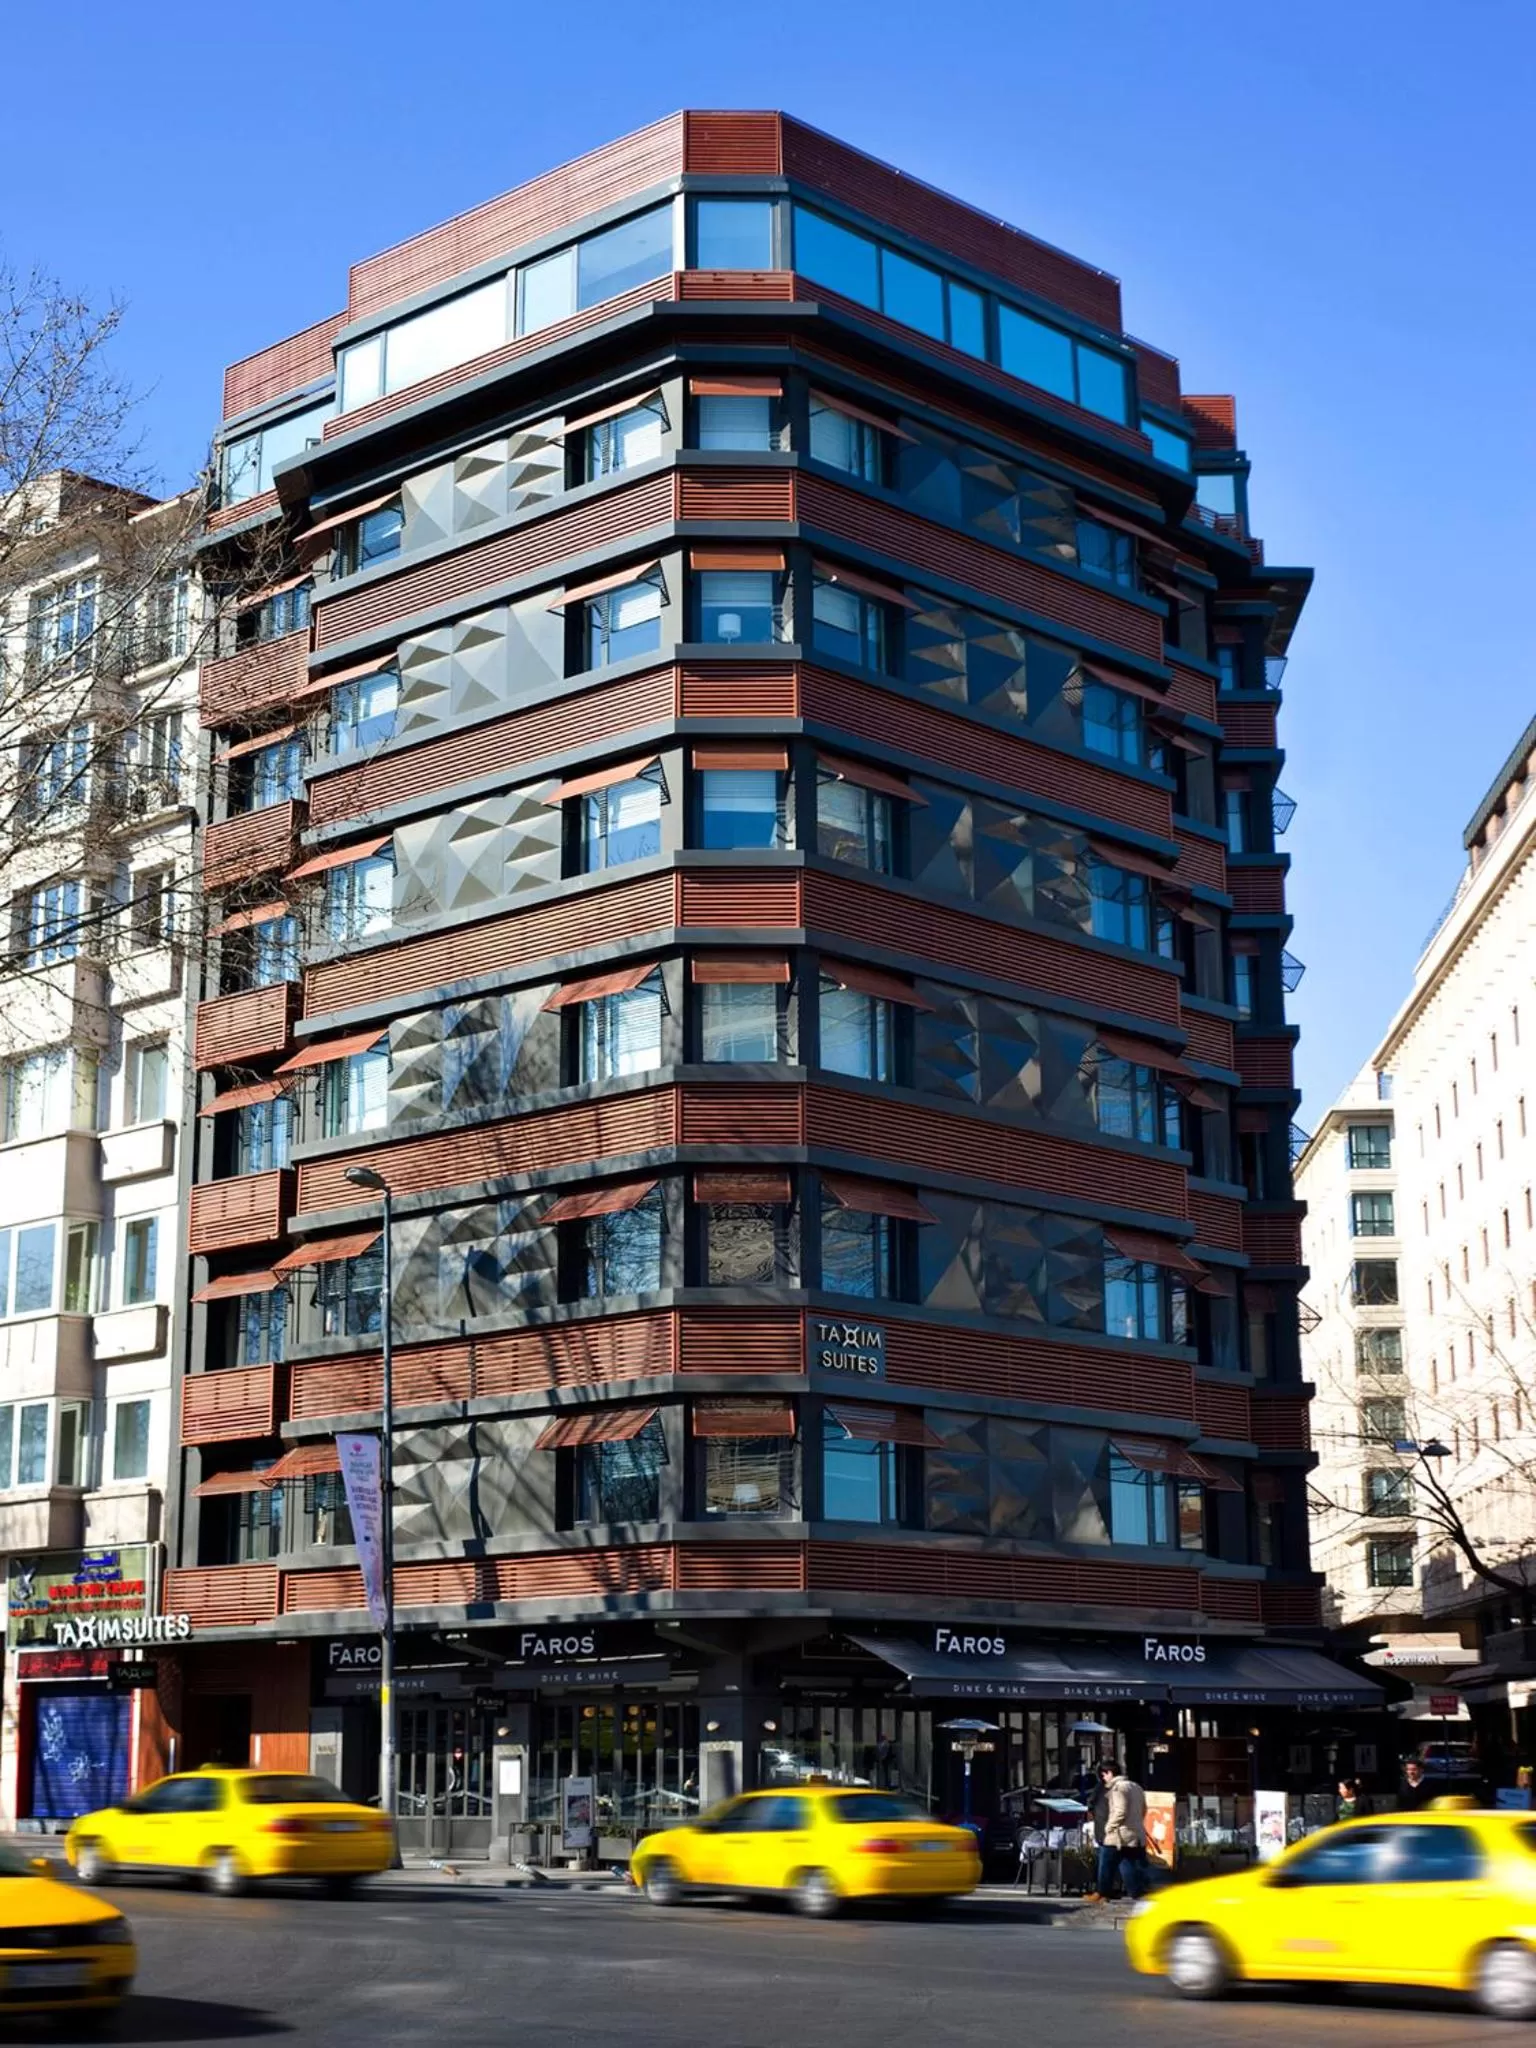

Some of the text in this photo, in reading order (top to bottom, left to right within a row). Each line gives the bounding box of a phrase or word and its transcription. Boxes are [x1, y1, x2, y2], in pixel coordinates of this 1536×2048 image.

[818, 1323, 882, 1349] TAXIM
[822, 1350, 878, 1374] SUITES
[329, 1642, 382, 1665] FARO
[521, 1632, 595, 1656] FAROS
[935, 1628, 1006, 1655] FAROS
[1144, 1638, 1206, 1662] FAROS
[953, 1684, 1027, 1694] DINE & WINE
[1064, 1687, 1090, 1696] DINE
[1106, 1688, 1133, 1696] WINE
